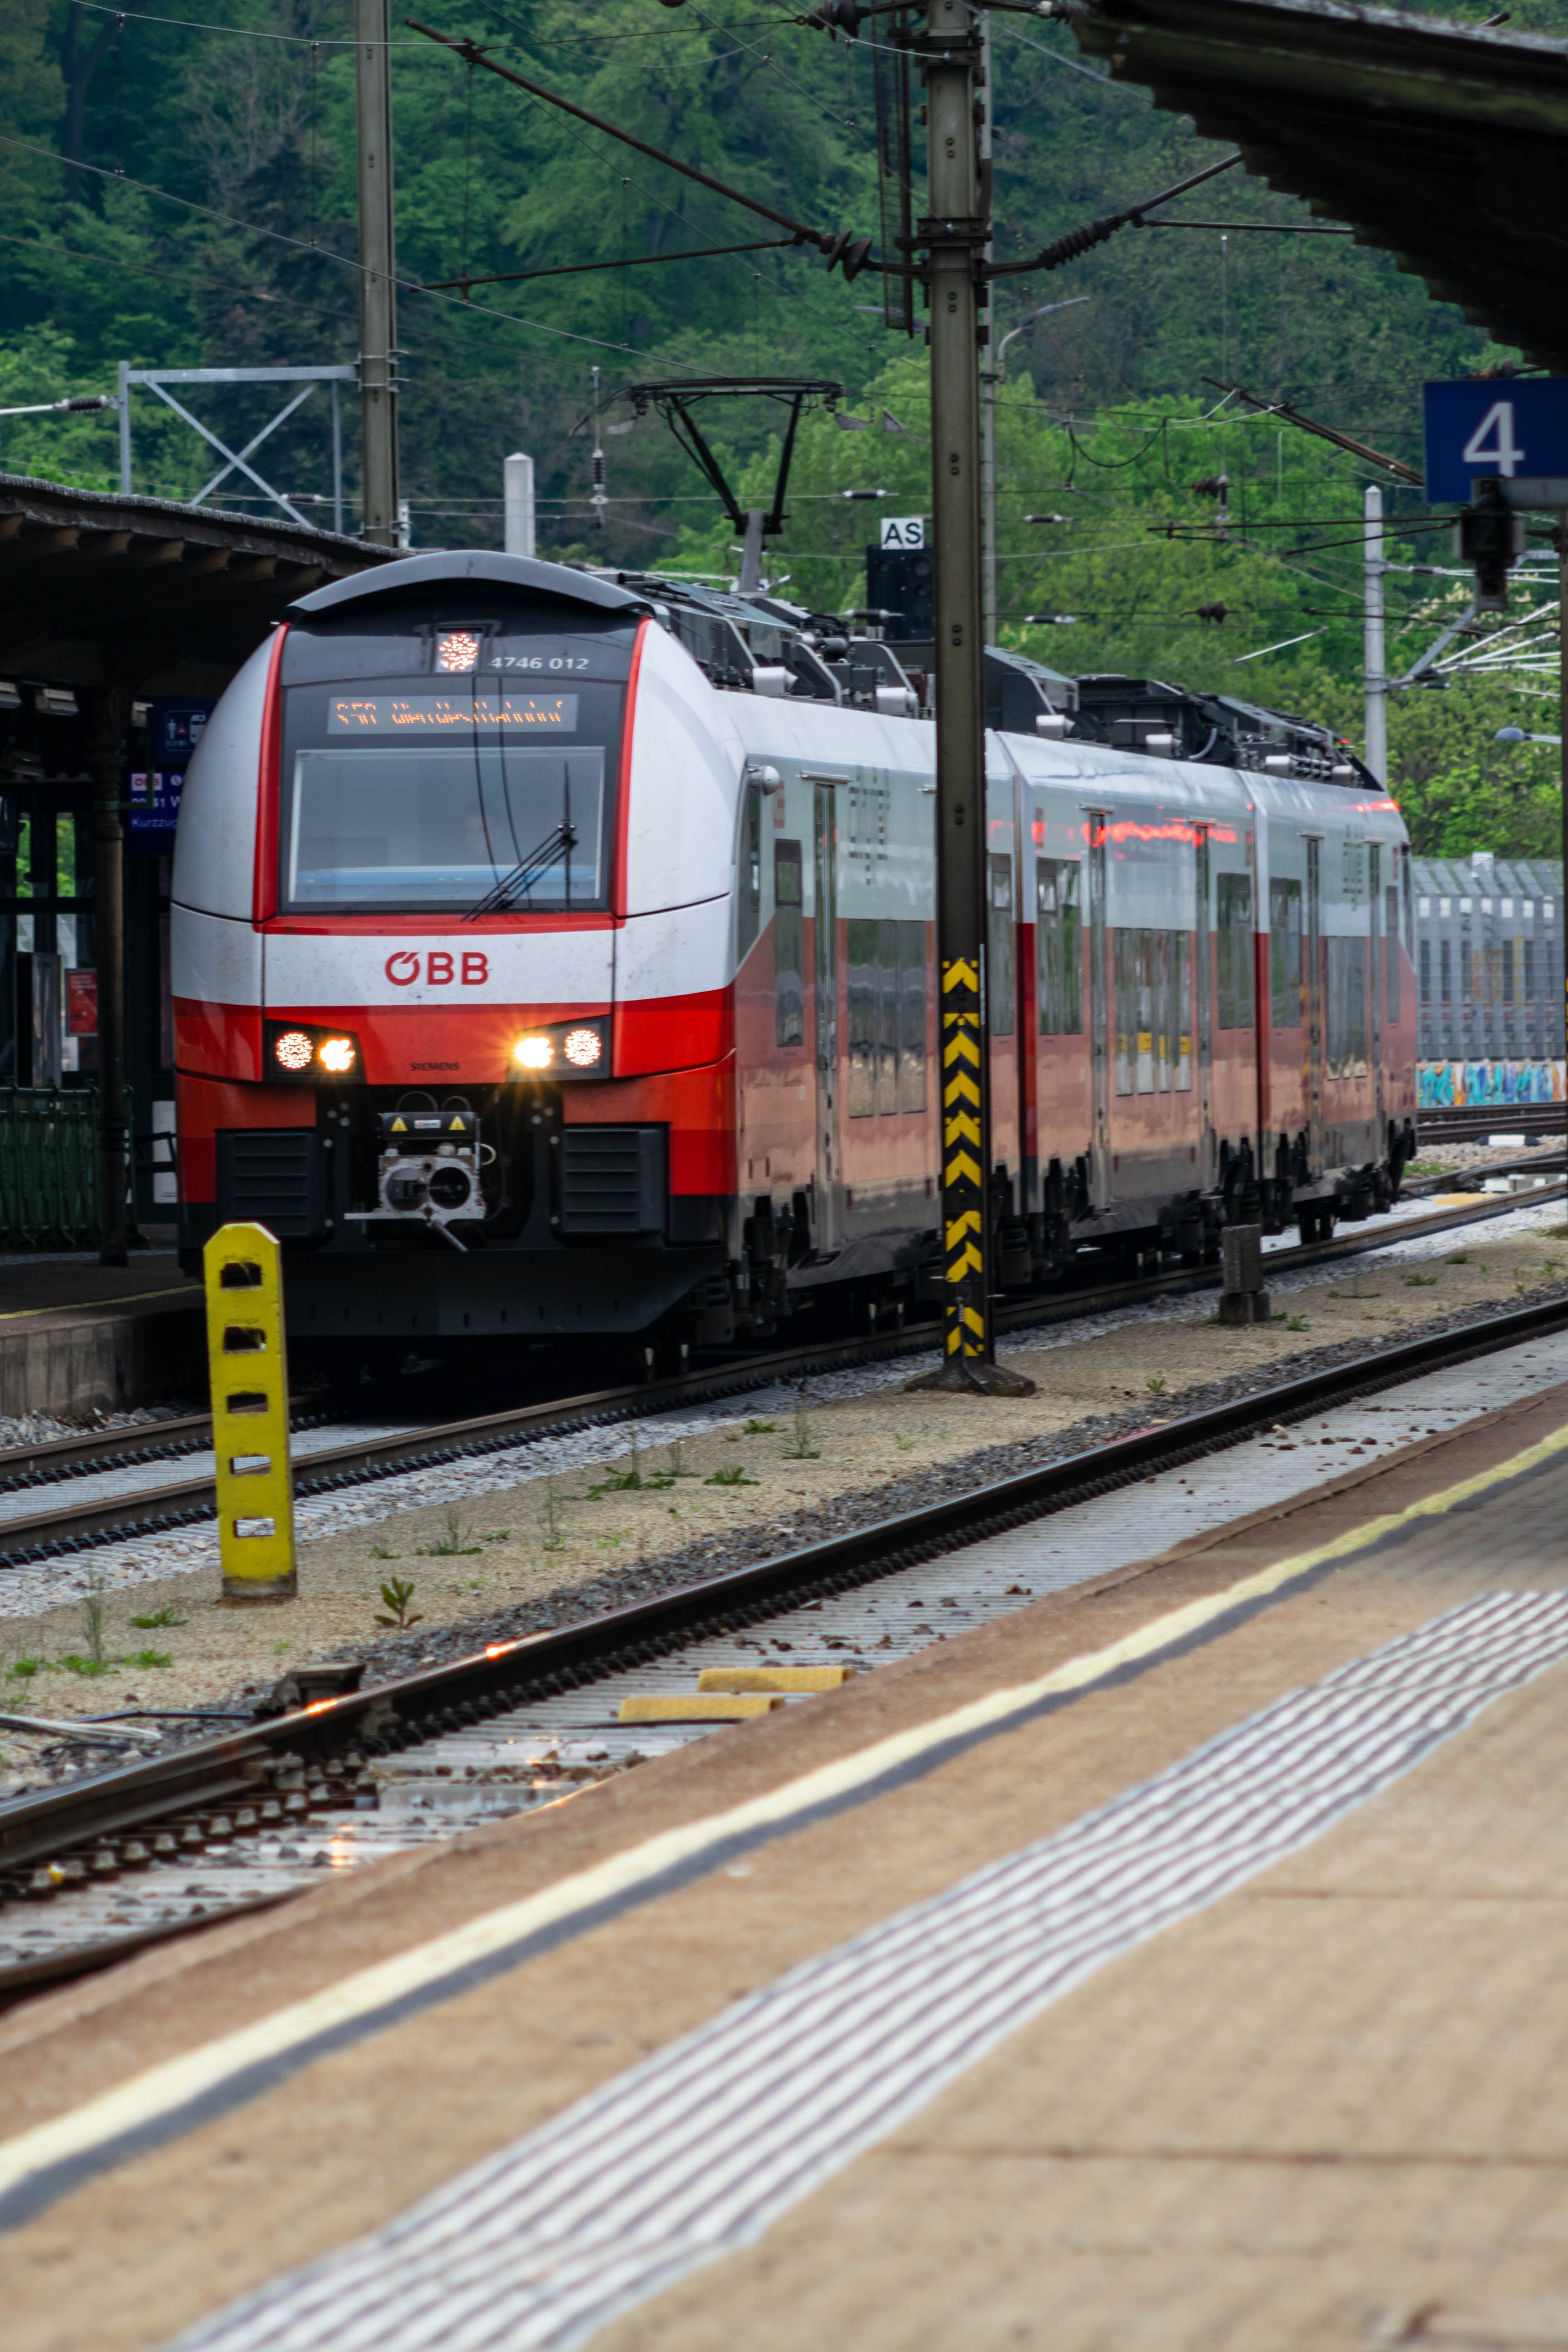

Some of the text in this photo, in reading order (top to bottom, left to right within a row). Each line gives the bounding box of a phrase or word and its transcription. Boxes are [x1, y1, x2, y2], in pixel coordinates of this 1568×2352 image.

[1463, 402, 1525, 477] 4
[884, 523, 921, 544] AS
[490, 657, 590, 670] 4746 012
[385, 951, 489, 986] ÖBB
[410, 1062, 460, 1071] SIEMENS
